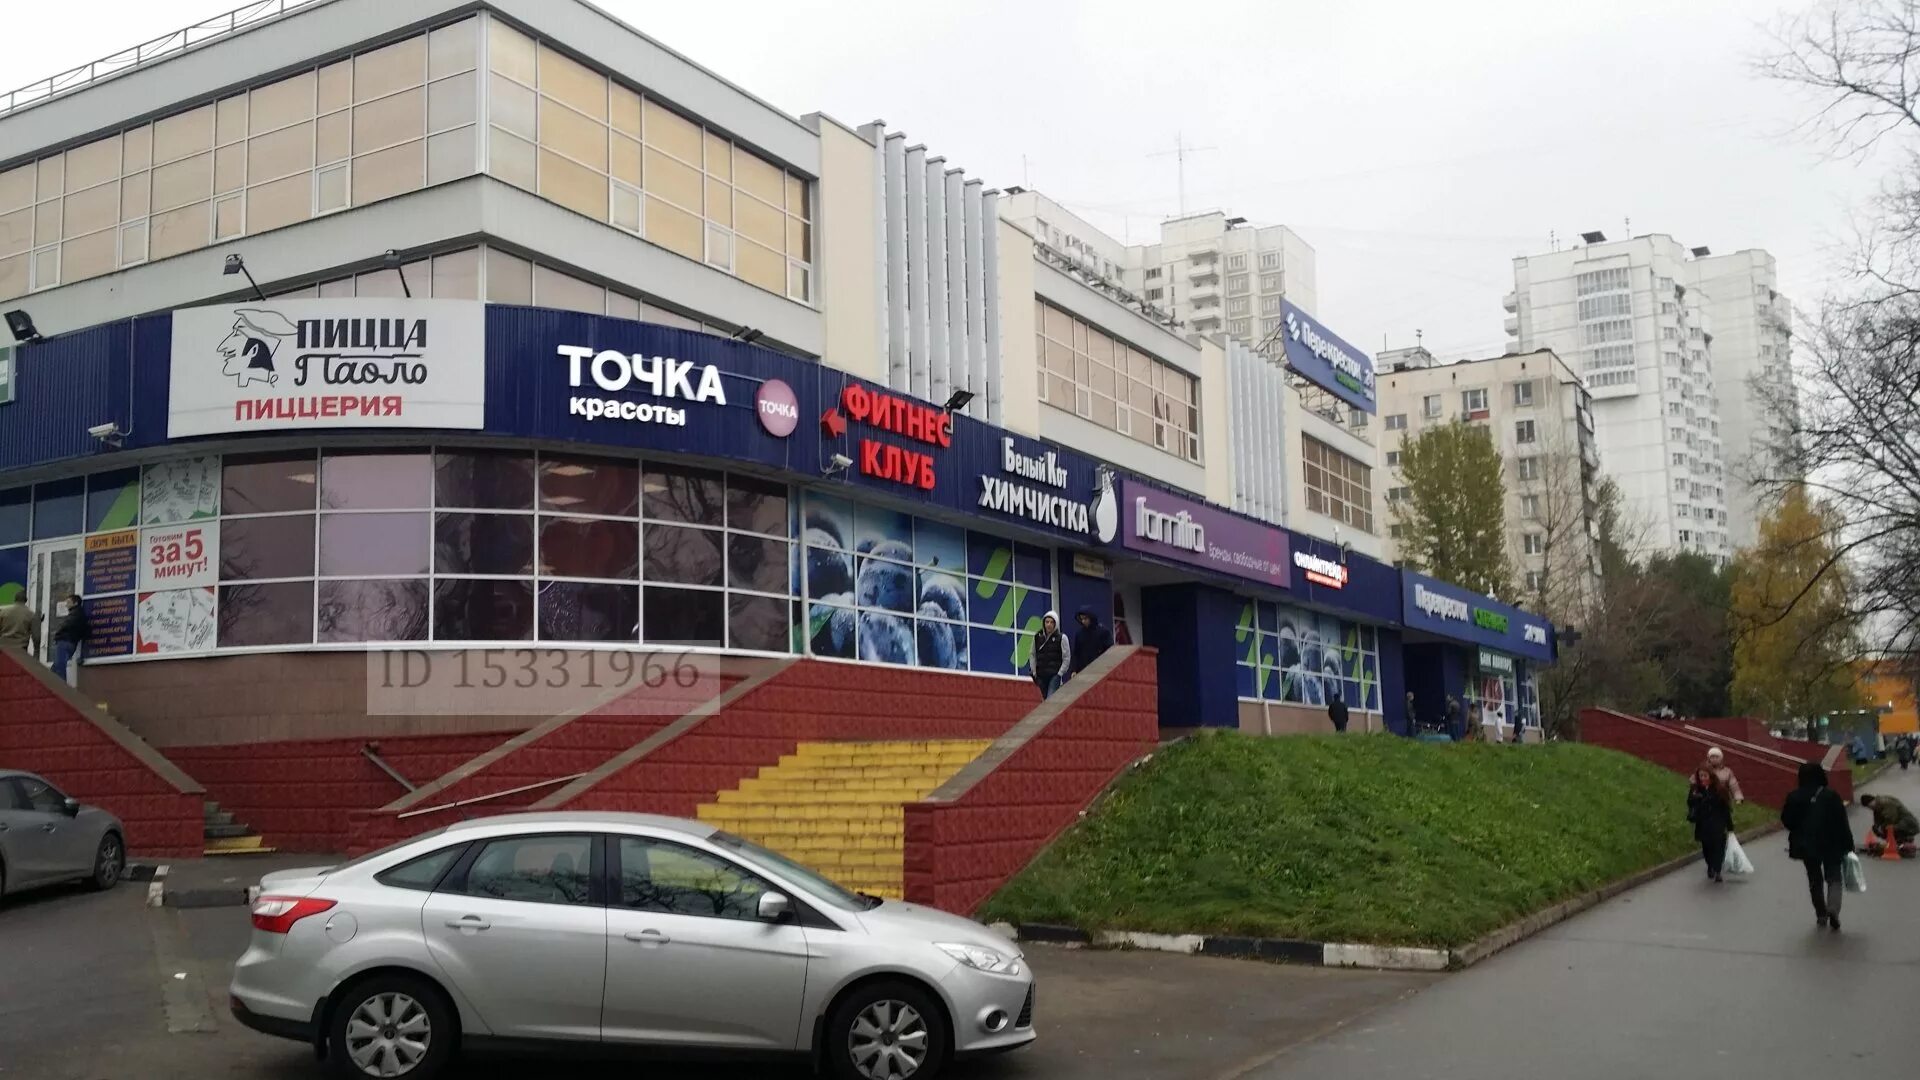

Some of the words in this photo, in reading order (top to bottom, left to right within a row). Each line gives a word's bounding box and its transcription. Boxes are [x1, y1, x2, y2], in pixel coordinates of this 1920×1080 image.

[296, 318, 427, 351] ПИЦЦА
[294, 352, 427, 385] Паоло
[557, 345, 726, 405] ТОЧКА
[235, 395, 402, 421] ПИЦЦЕРИЯ
[569, 396, 686, 426] красоты
[759, 398, 797, 420] ТОЧКА
[841, 383, 951, 448] ФИТНЕС
[860, 438, 936, 490] КЛУБ
[1003, 437, 1045, 483] Белый
[1045, 451, 1067, 489] Кот
[980, 474, 1089, 534] ХИМЧИСТКА
[150, 543, 181, 565] за
[185, 529, 203, 560] 5
[154, 556, 208, 579] минут!
